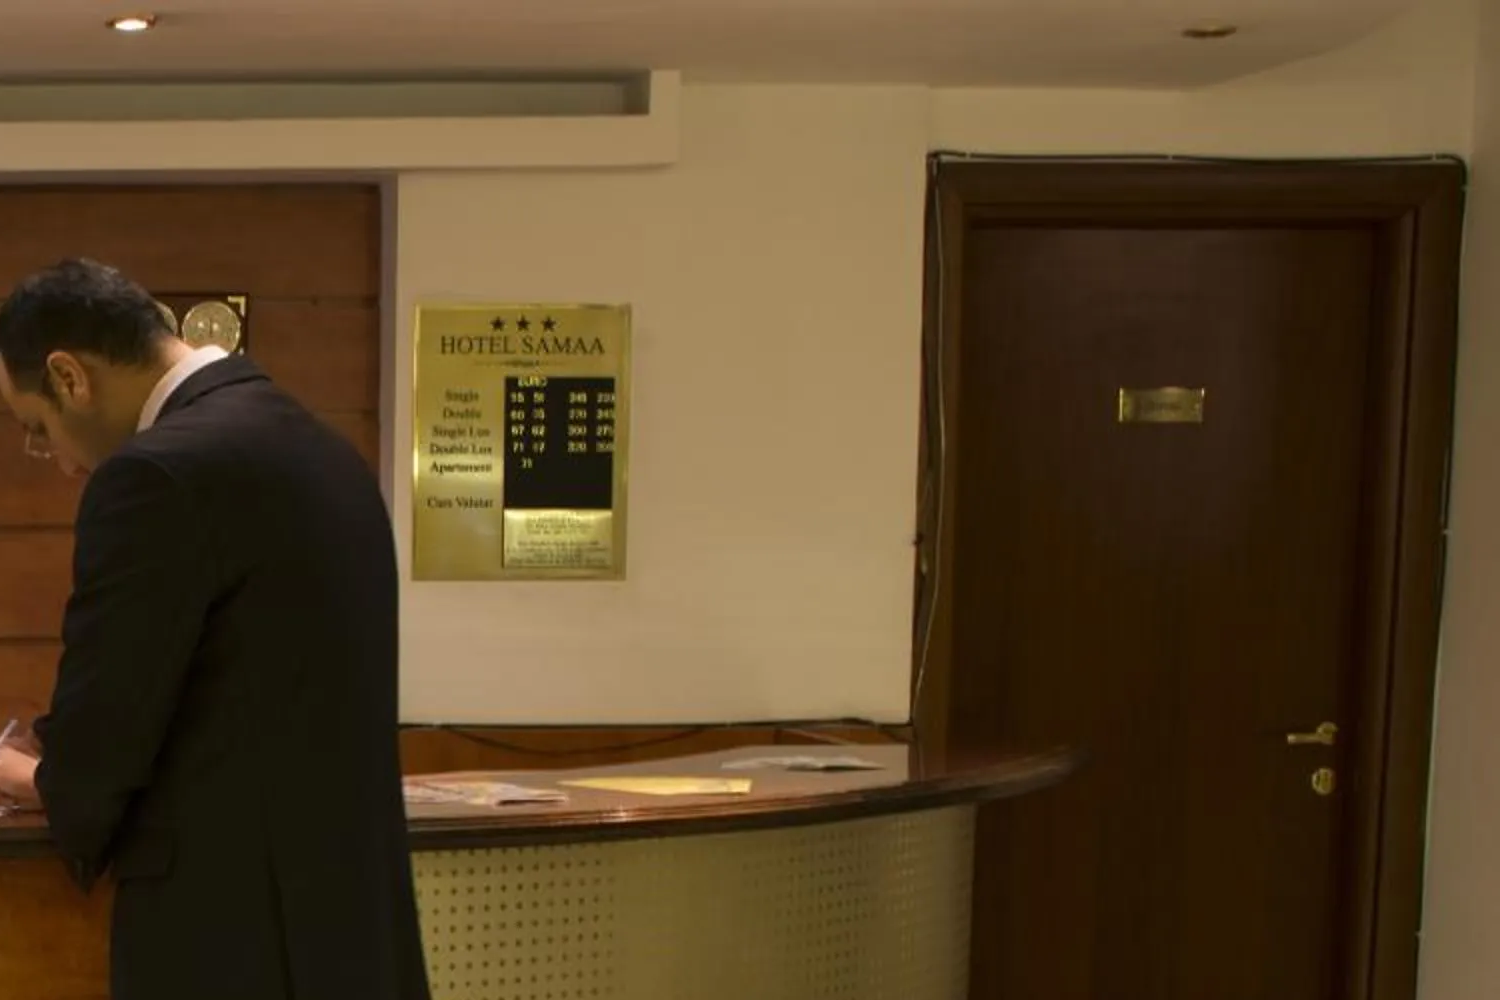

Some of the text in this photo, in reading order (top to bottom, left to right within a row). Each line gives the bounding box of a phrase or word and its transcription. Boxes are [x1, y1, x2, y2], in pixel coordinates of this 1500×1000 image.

[440, 335, 606, 355] HOTEL SAMAA
[445, 388, 480, 403] Single
[442, 406, 482, 420] Double
[431, 425, 467, 439] Single
[429, 442, 468, 455] Double
